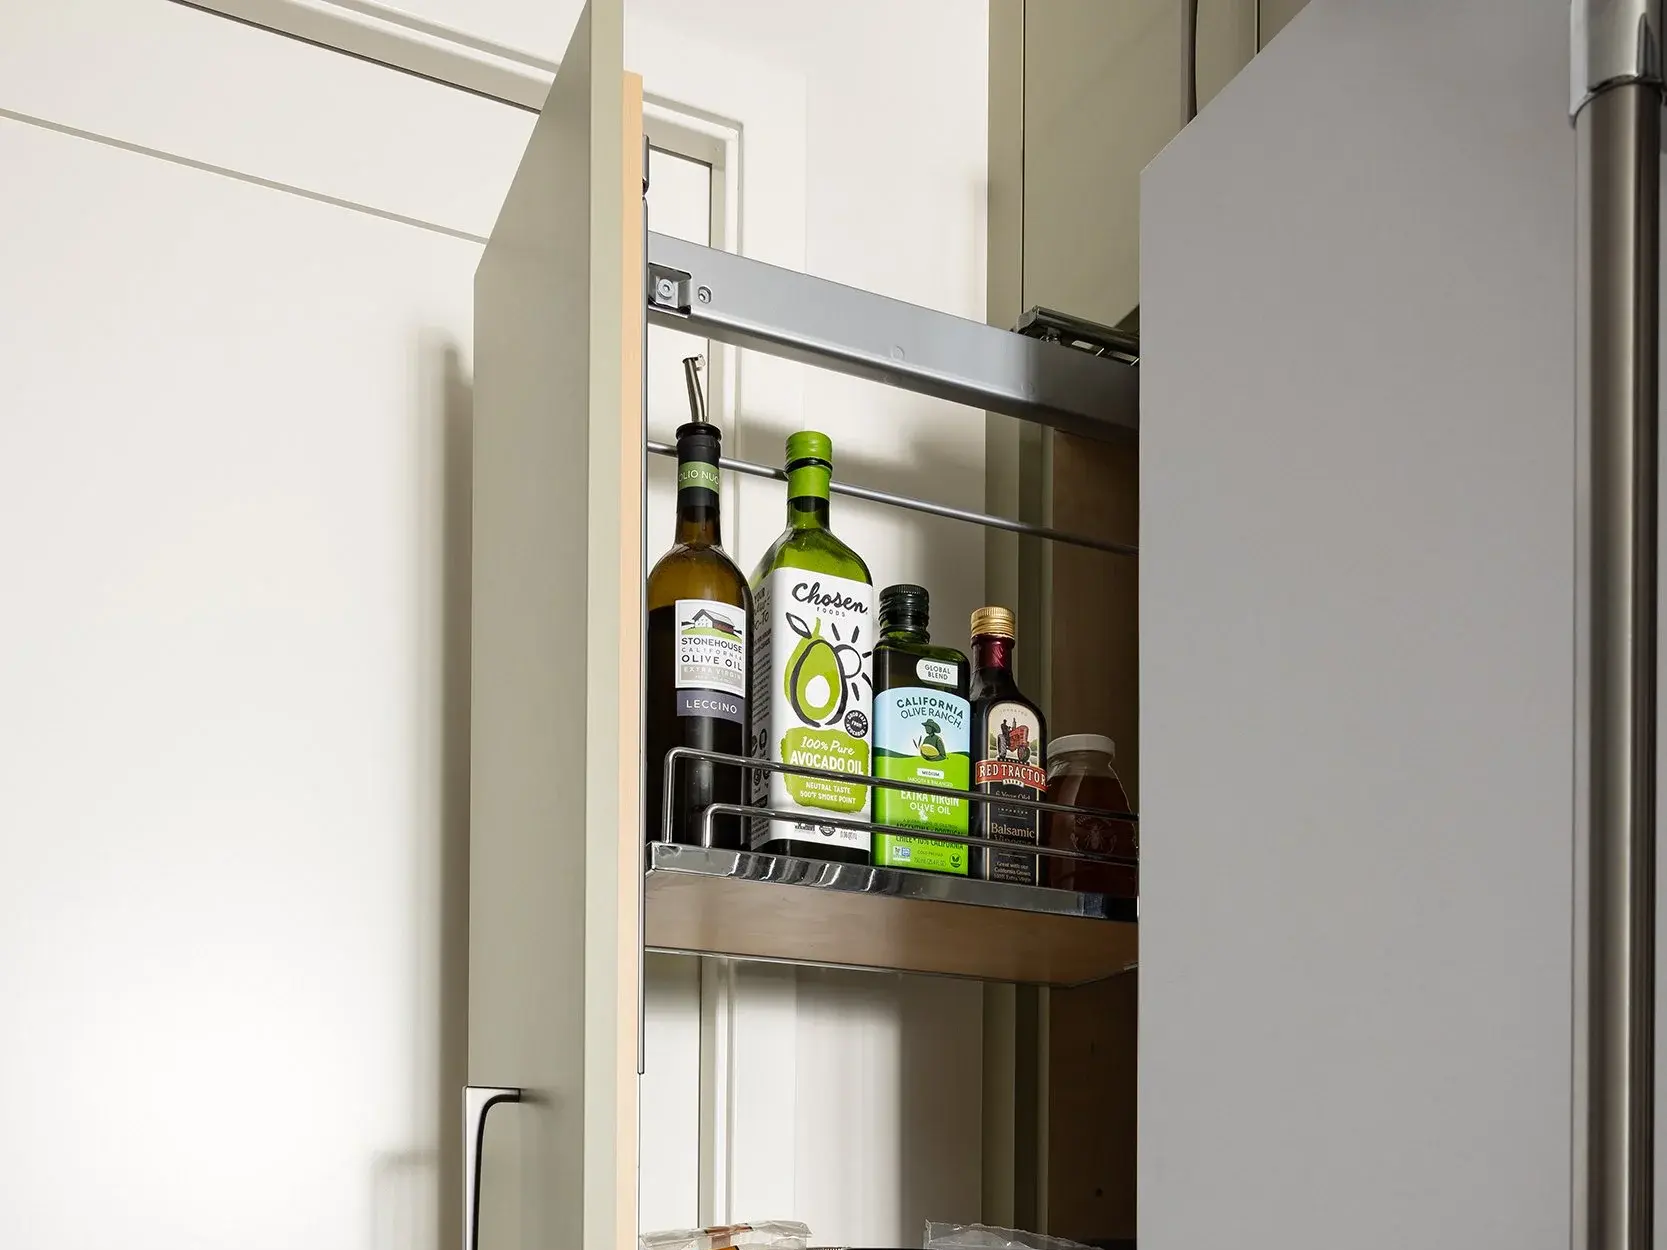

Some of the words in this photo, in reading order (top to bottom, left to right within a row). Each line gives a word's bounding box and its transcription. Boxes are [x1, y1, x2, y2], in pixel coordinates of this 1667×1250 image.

[791, 581, 869, 614] Chosen
[816, 606, 846, 617] FOODS
[681, 637, 743, 654] STONEHOUSE
[681, 654, 720, 665] OLIVE
[724, 658, 743, 671] OIL
[924, 663, 951, 675] GLOBAL
[927, 671, 948, 680] BLEND
[686, 699, 738, 714] LECCINO
[896, 696, 964, 719] CALIFORNIA
[900, 706, 927, 719] OLIVE
[800, 735, 828, 751] 100%
[829, 740, 856, 756] Pure
[789, 750, 845, 772] AVOCADO
[847, 760, 864, 775] OIL
[979, 764, 999, 778] RED
[1000, 764, 1047, 787] TRACTOR
[805, 781, 831, 792] NEUTRAL
[832, 785, 851, 794] TASTE
[818, 793, 838, 803] SMOKE
[838, 796, 857, 805] POINT
[909, 802, 935, 813] OLIVE
[937, 806, 951, 815] OIL
[991, 822, 1036, 838] Balsamic
